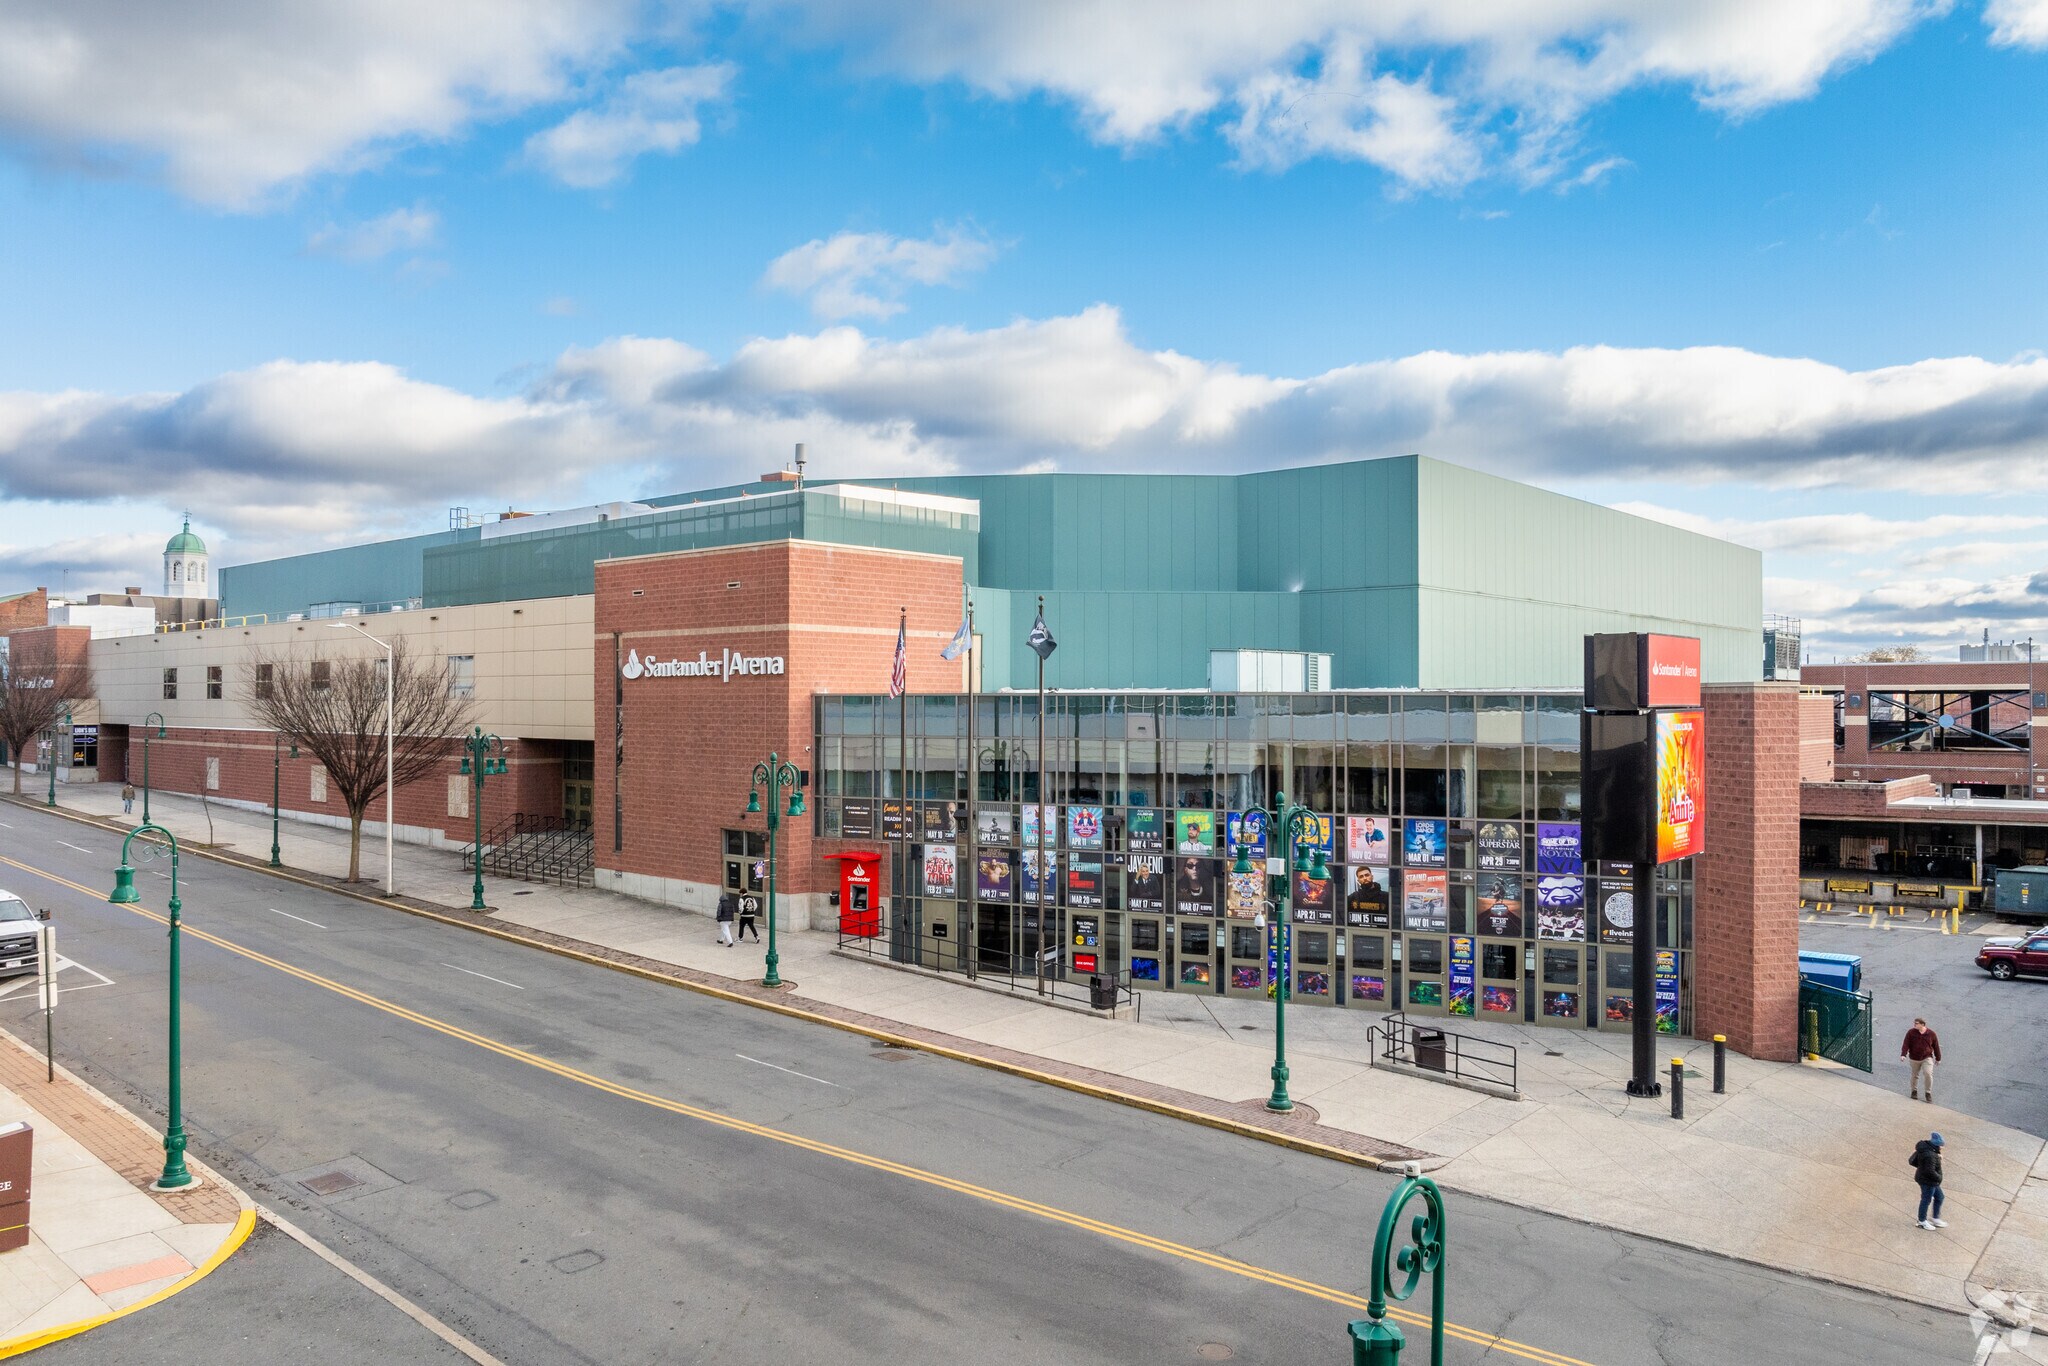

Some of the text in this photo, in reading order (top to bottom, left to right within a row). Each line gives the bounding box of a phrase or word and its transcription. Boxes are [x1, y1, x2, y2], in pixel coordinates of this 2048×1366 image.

[645, 651, 785, 677] Santander Arena
[1658, 663, 1697, 677] Santander Arena
[1669, 796, 1695, 825] Annie
[1181, 814, 1209, 824] GROW
[1199, 822, 1211, 832] UP
[928, 830, 937, 839] MAY
[981, 832, 990, 841] APR
[991, 833, 997, 841] 23
[1026, 835, 1035, 844] APR
[1072, 837, 1081, 846] APR
[1131, 840, 1141, 848] MAY
[1142, 840, 1146, 849] 4
[1479, 840, 1521, 849] SUPERSTAR
[1180, 843, 1191, 851] MAR
[1352, 850, 1363, 859] NOV
[1364, 850, 1372, 860] 02
[1408, 852, 1421, 862] MAR
[1422, 853, 1429, 863] 01
[1540, 848, 1582, 858] ROYALS
[1128, 855, 1142, 873] JAY
[1482, 856, 1494, 866] APR
[1495, 856, 1503, 866] 29
[926, 863, 954, 873] WORLD
[1406, 874, 1427, 882] STAIND
[936, 886, 941, 894] 23
[982, 889, 990, 898] APR
[991, 889, 997, 898] 27
[1025, 892, 1036, 900] MAR
[1071, 894, 1082, 903] MAR
[1131, 899, 1142, 908] MAY
[1143, 899, 1148, 908] 17
[1181, 902, 1192, 911] MAR
[1192, 903, 1199, 912] 07
[1297, 910, 1308, 919] APR
[1309, 910, 1316, 920] 21
[1351, 913, 1362, 922] JUN
[1363, 914, 1370, 923] 15
[1409, 917, 1421, 927] MAY
[1422, 918, 1429, 927] 01
